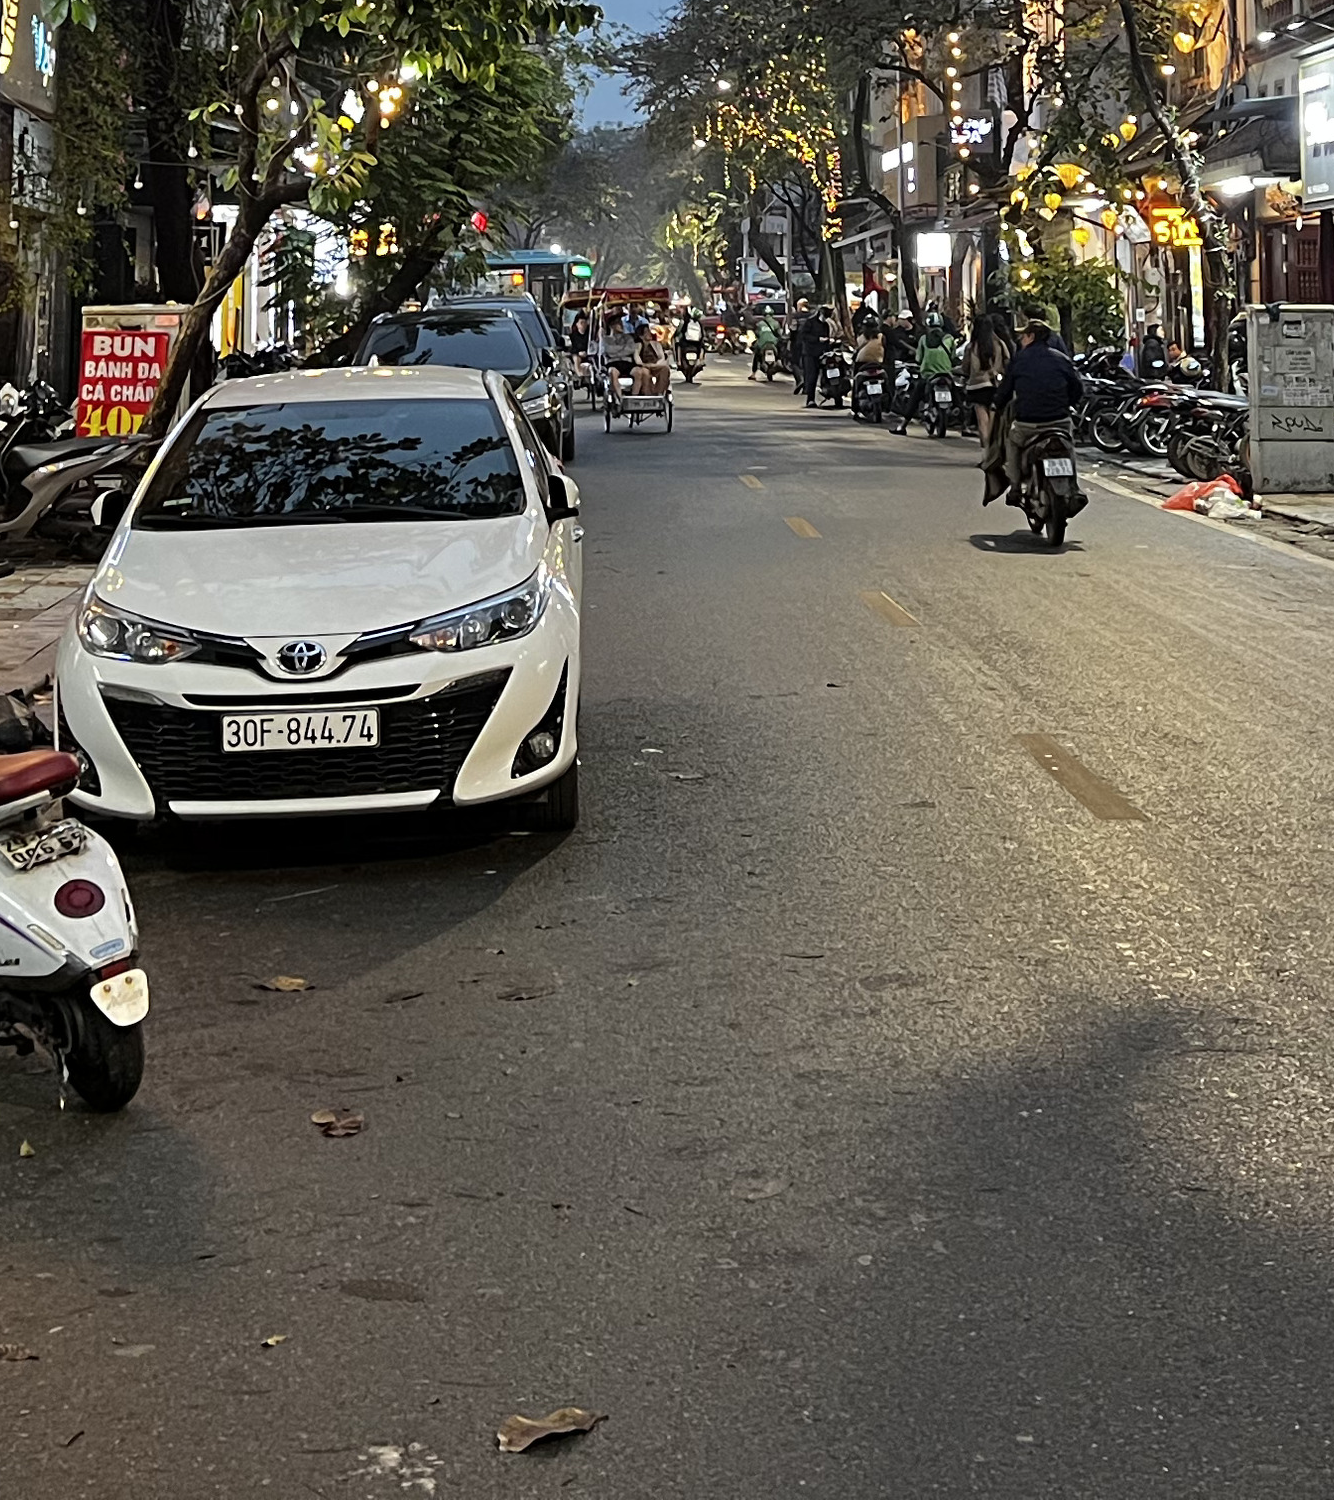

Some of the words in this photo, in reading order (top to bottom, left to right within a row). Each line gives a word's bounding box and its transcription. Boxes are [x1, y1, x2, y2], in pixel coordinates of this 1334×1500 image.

[84, 358, 133, 379] BÁNH
[137, 362, 161, 379] ĐA
[81, 383, 105, 401] CÁ
[226, 714, 374, 749] 30F-844.74
